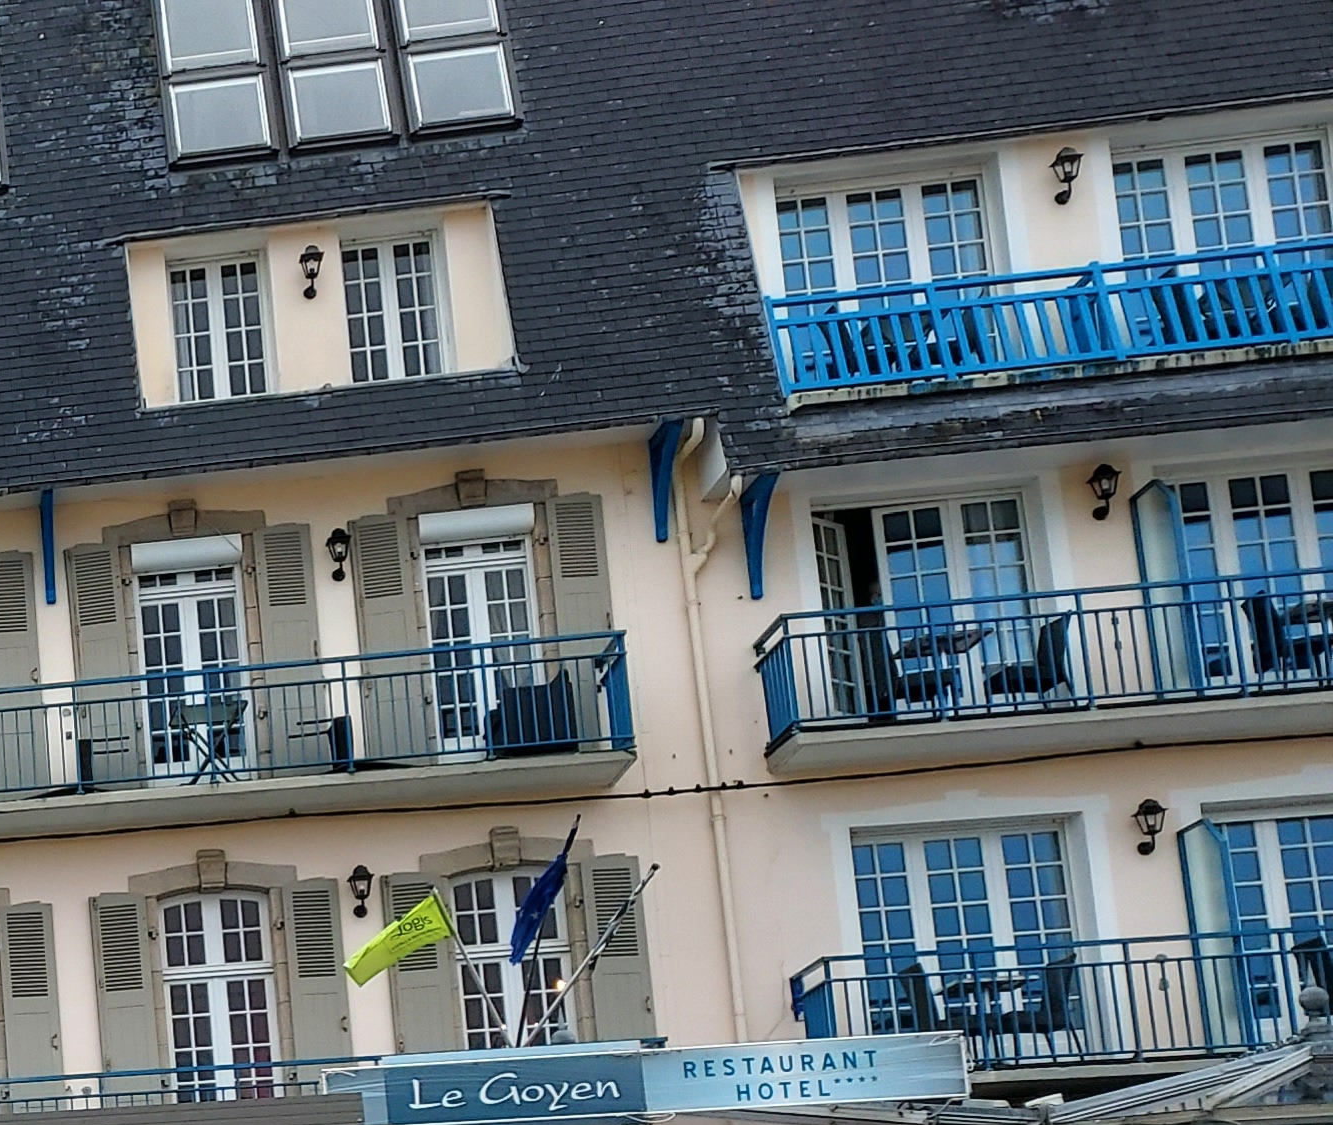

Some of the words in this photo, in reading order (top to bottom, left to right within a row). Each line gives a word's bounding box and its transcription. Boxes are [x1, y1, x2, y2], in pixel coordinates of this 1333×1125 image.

[683, 1050, 877, 1078] RESTAURANT
[408, 1078, 467, 1109] Le
[479, 1072, 620, 1111] Goyen
